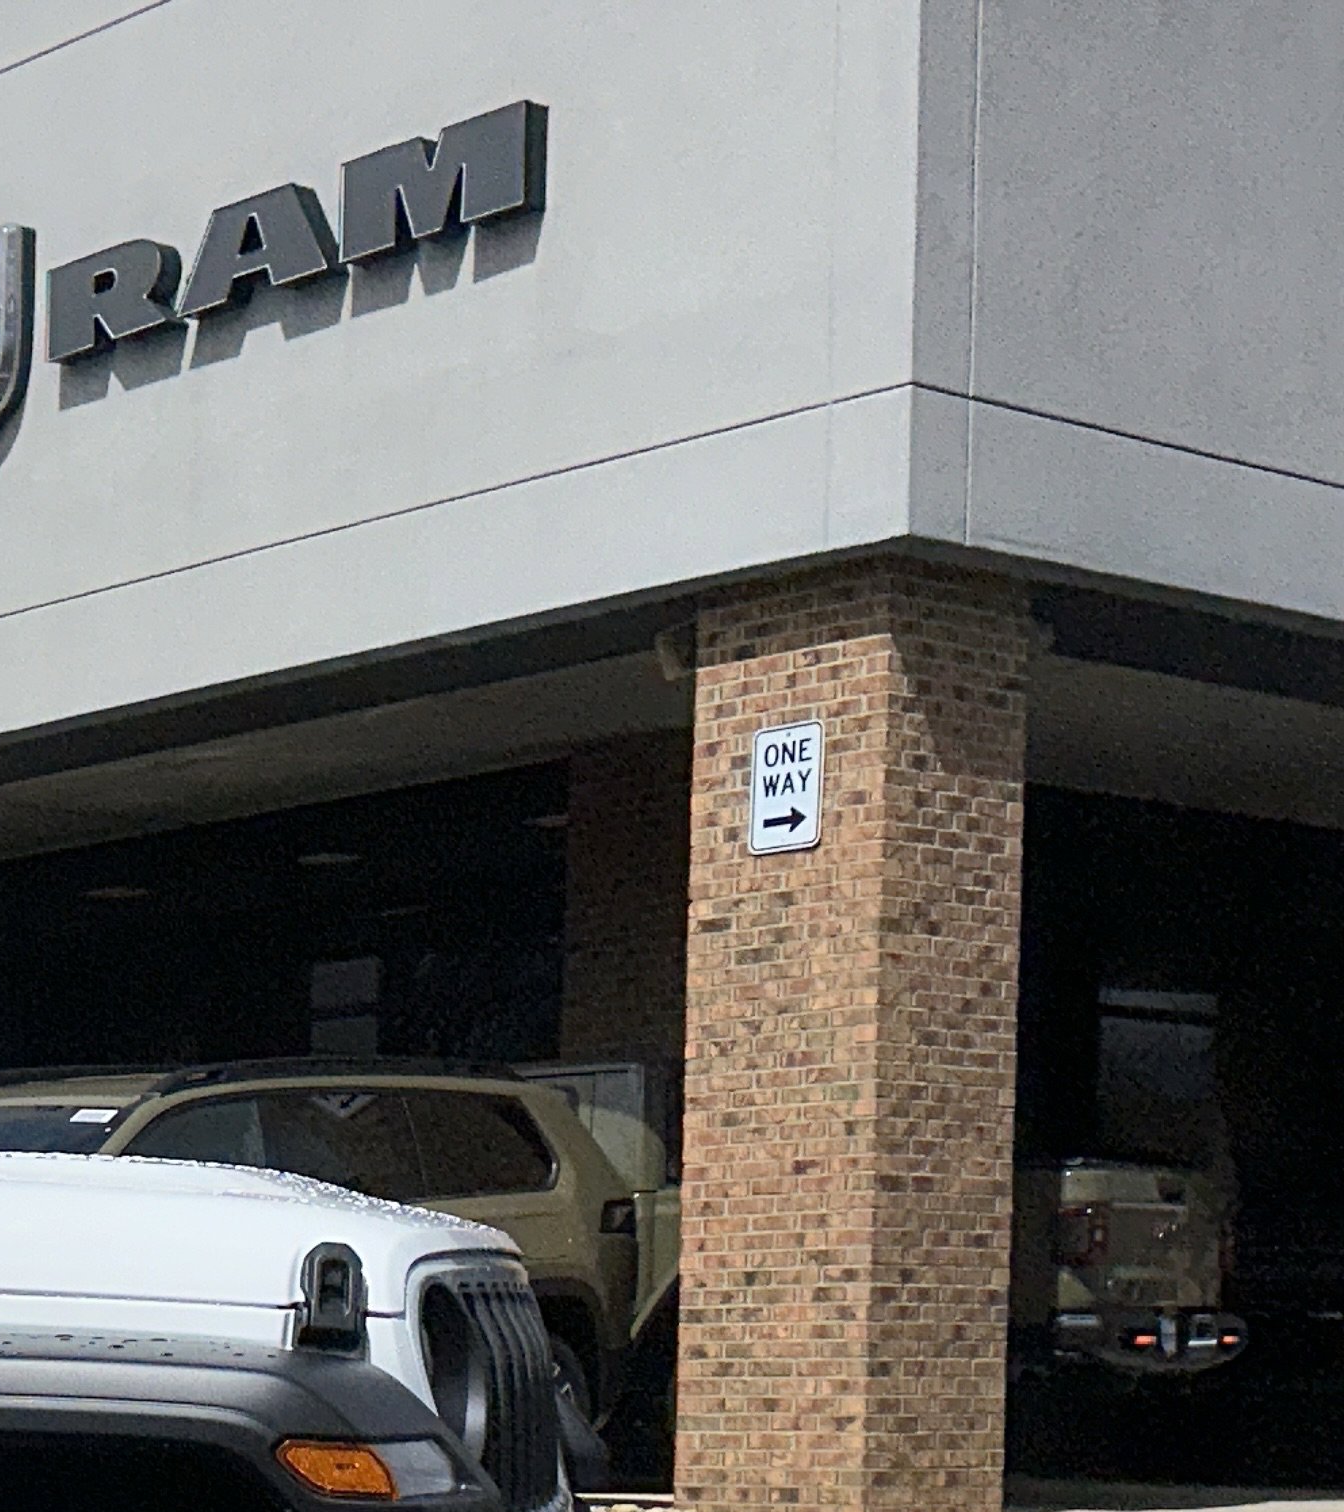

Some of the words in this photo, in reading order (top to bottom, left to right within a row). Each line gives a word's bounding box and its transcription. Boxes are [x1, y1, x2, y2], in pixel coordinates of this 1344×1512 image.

[45, 99, 549, 363] RAM
[764, 738, 812, 767] ONE
[763, 768, 812, 798] WAY
